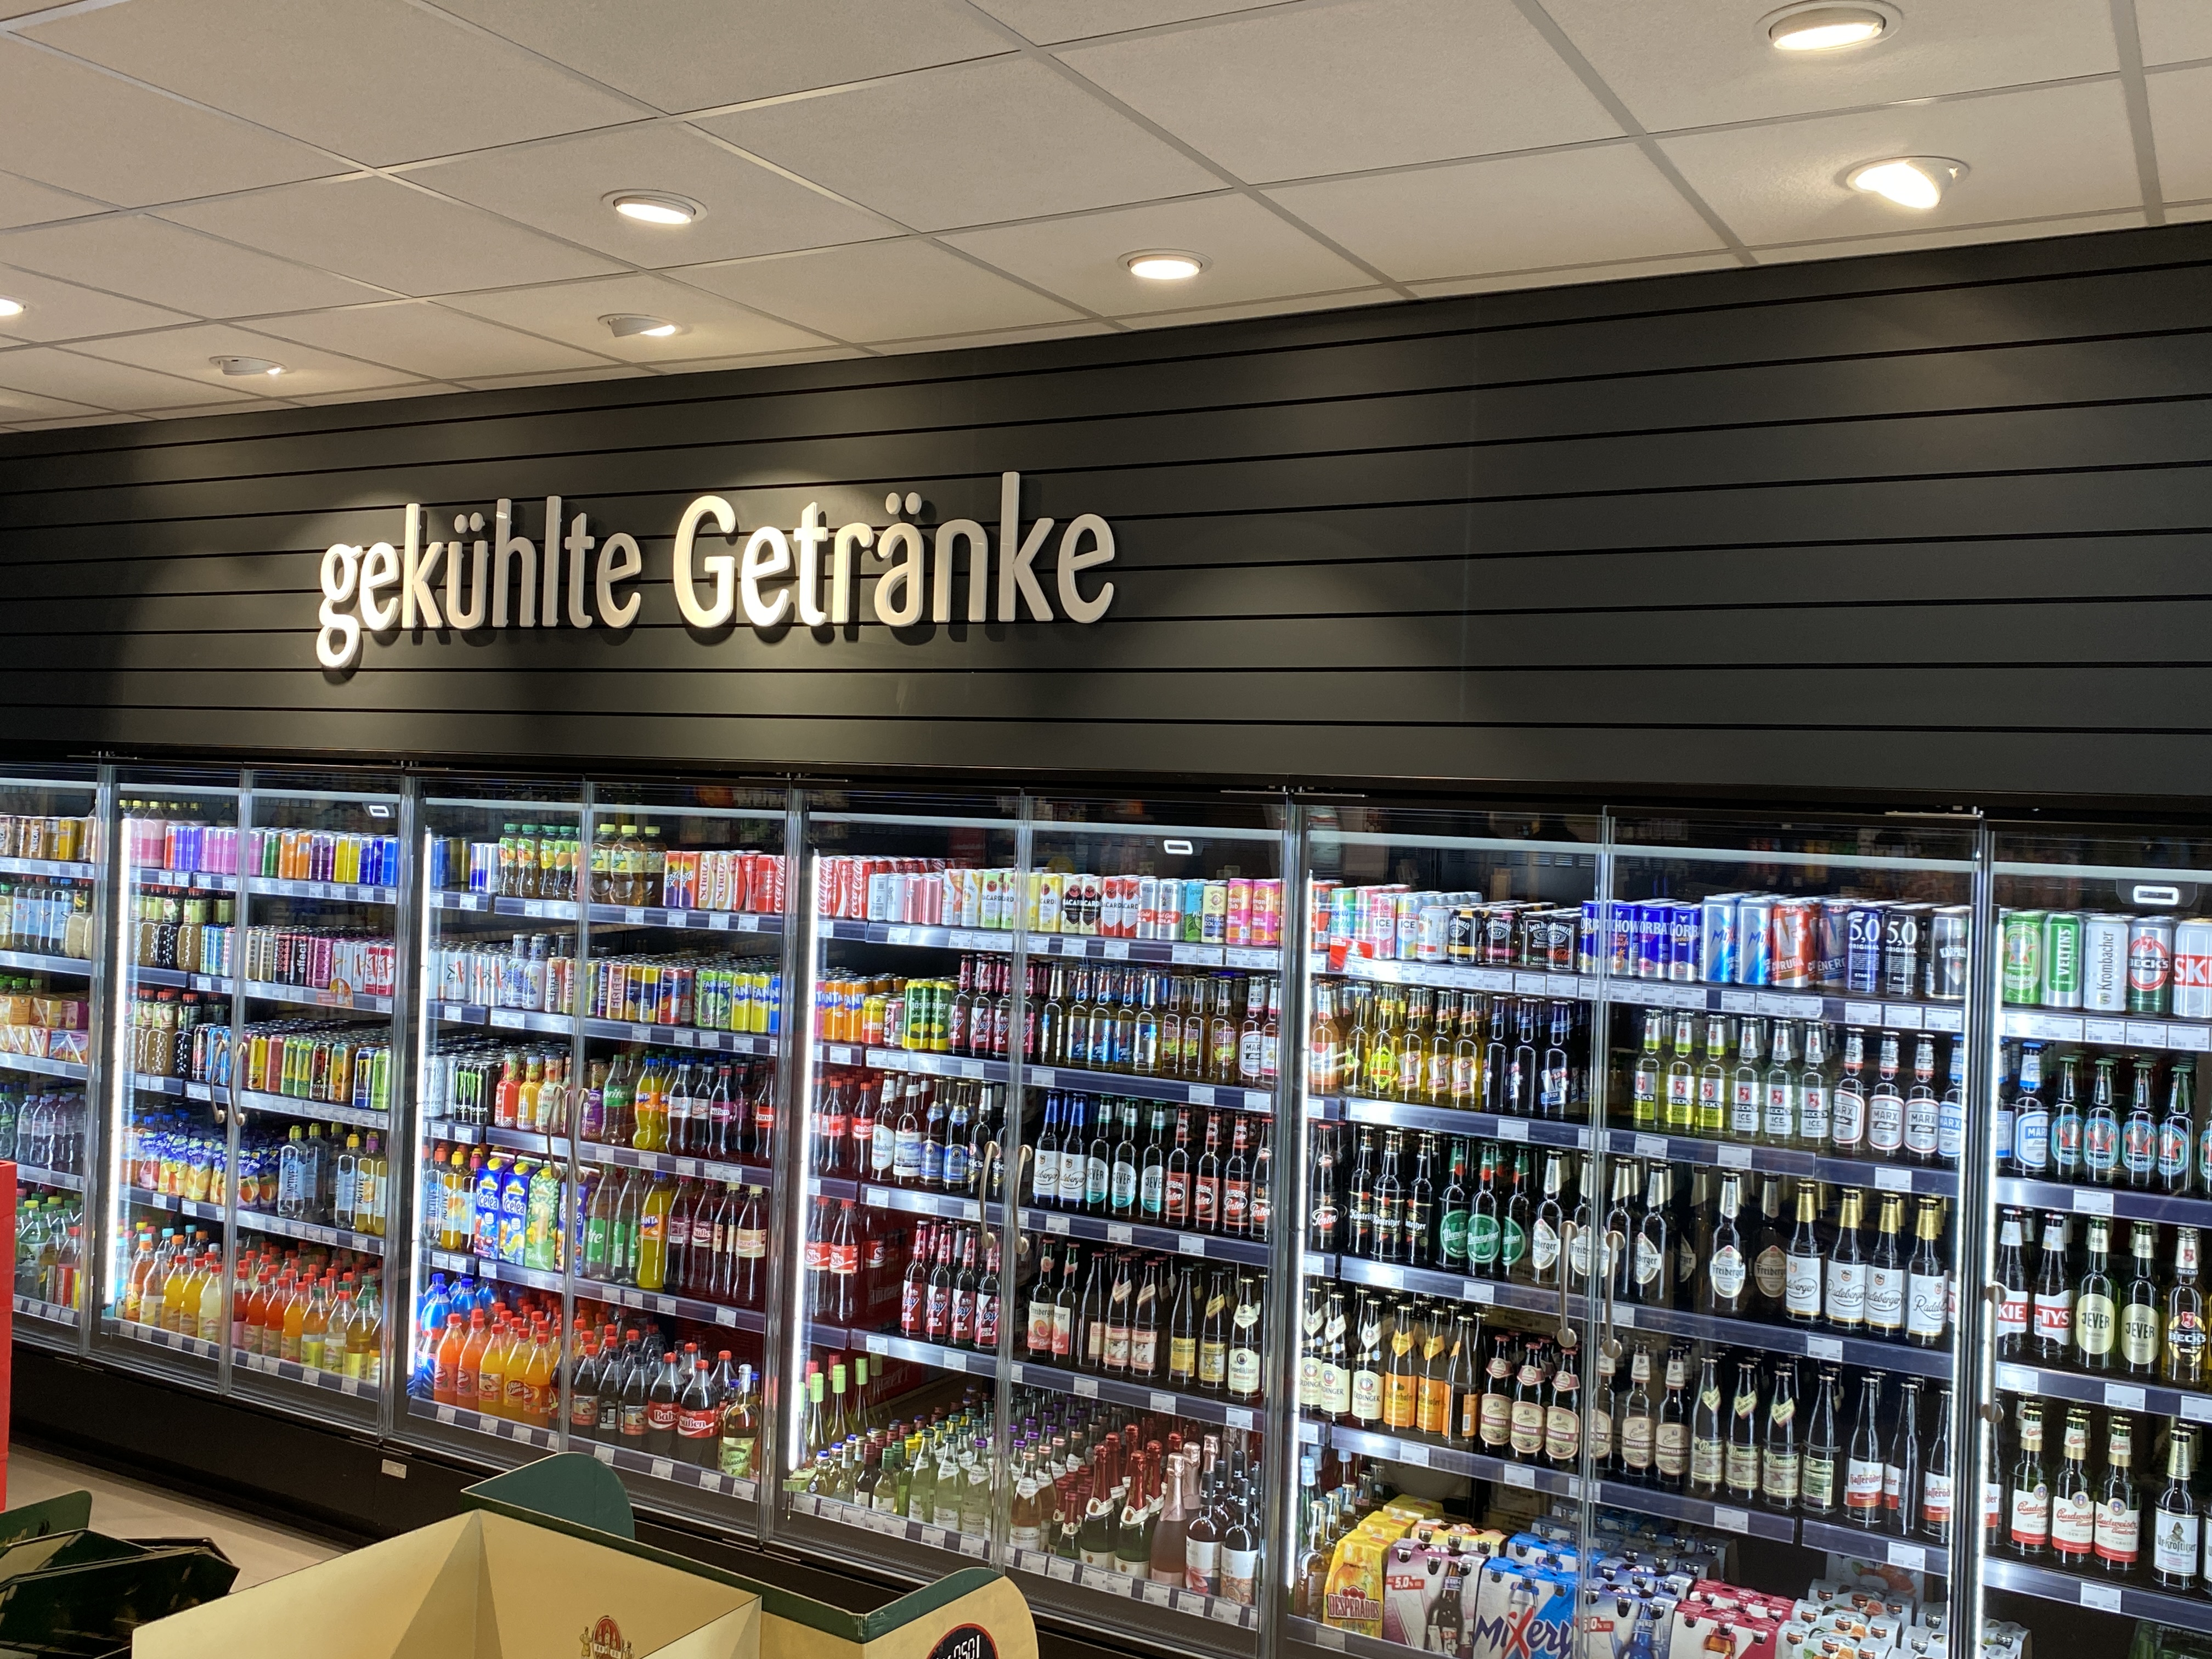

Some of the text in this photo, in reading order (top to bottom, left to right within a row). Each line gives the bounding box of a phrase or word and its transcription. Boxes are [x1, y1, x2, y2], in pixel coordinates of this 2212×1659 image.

[316, 471, 1115, 670] gekühlte Getränke
[699, 862, 709, 900] Schatz
[716, 862, 726, 901] Schatz
[1375, 918, 1391, 927] ICE
[1400, 920, 1415, 929] ICE
[1849, 918, 1881, 943] 5,0
[1886, 921, 1917, 946] 5,0
[1848, 943, 1880, 951] ORIGINAL
[2057, 929, 2072, 977] VELTINS
[298, 940, 307, 973] effect
[2101, 931, 2115, 992] Krombacher
[1874, 1110, 1898, 1121] MARX
[1911, 1113, 1936, 1125] MARX
[527, 1251, 548, 1262] GRÜNE
[1998, 1304, 2025, 1321] KIE
[2041, 1308, 2070, 1326] TYS
[2081, 1313, 2110, 1329] JEVER
[2125, 1322, 2155, 1339] JEVER
[2168, 1331, 2206, 1344] BECK'S
[1328, 1592, 1381, 1621] DESPERADOS
